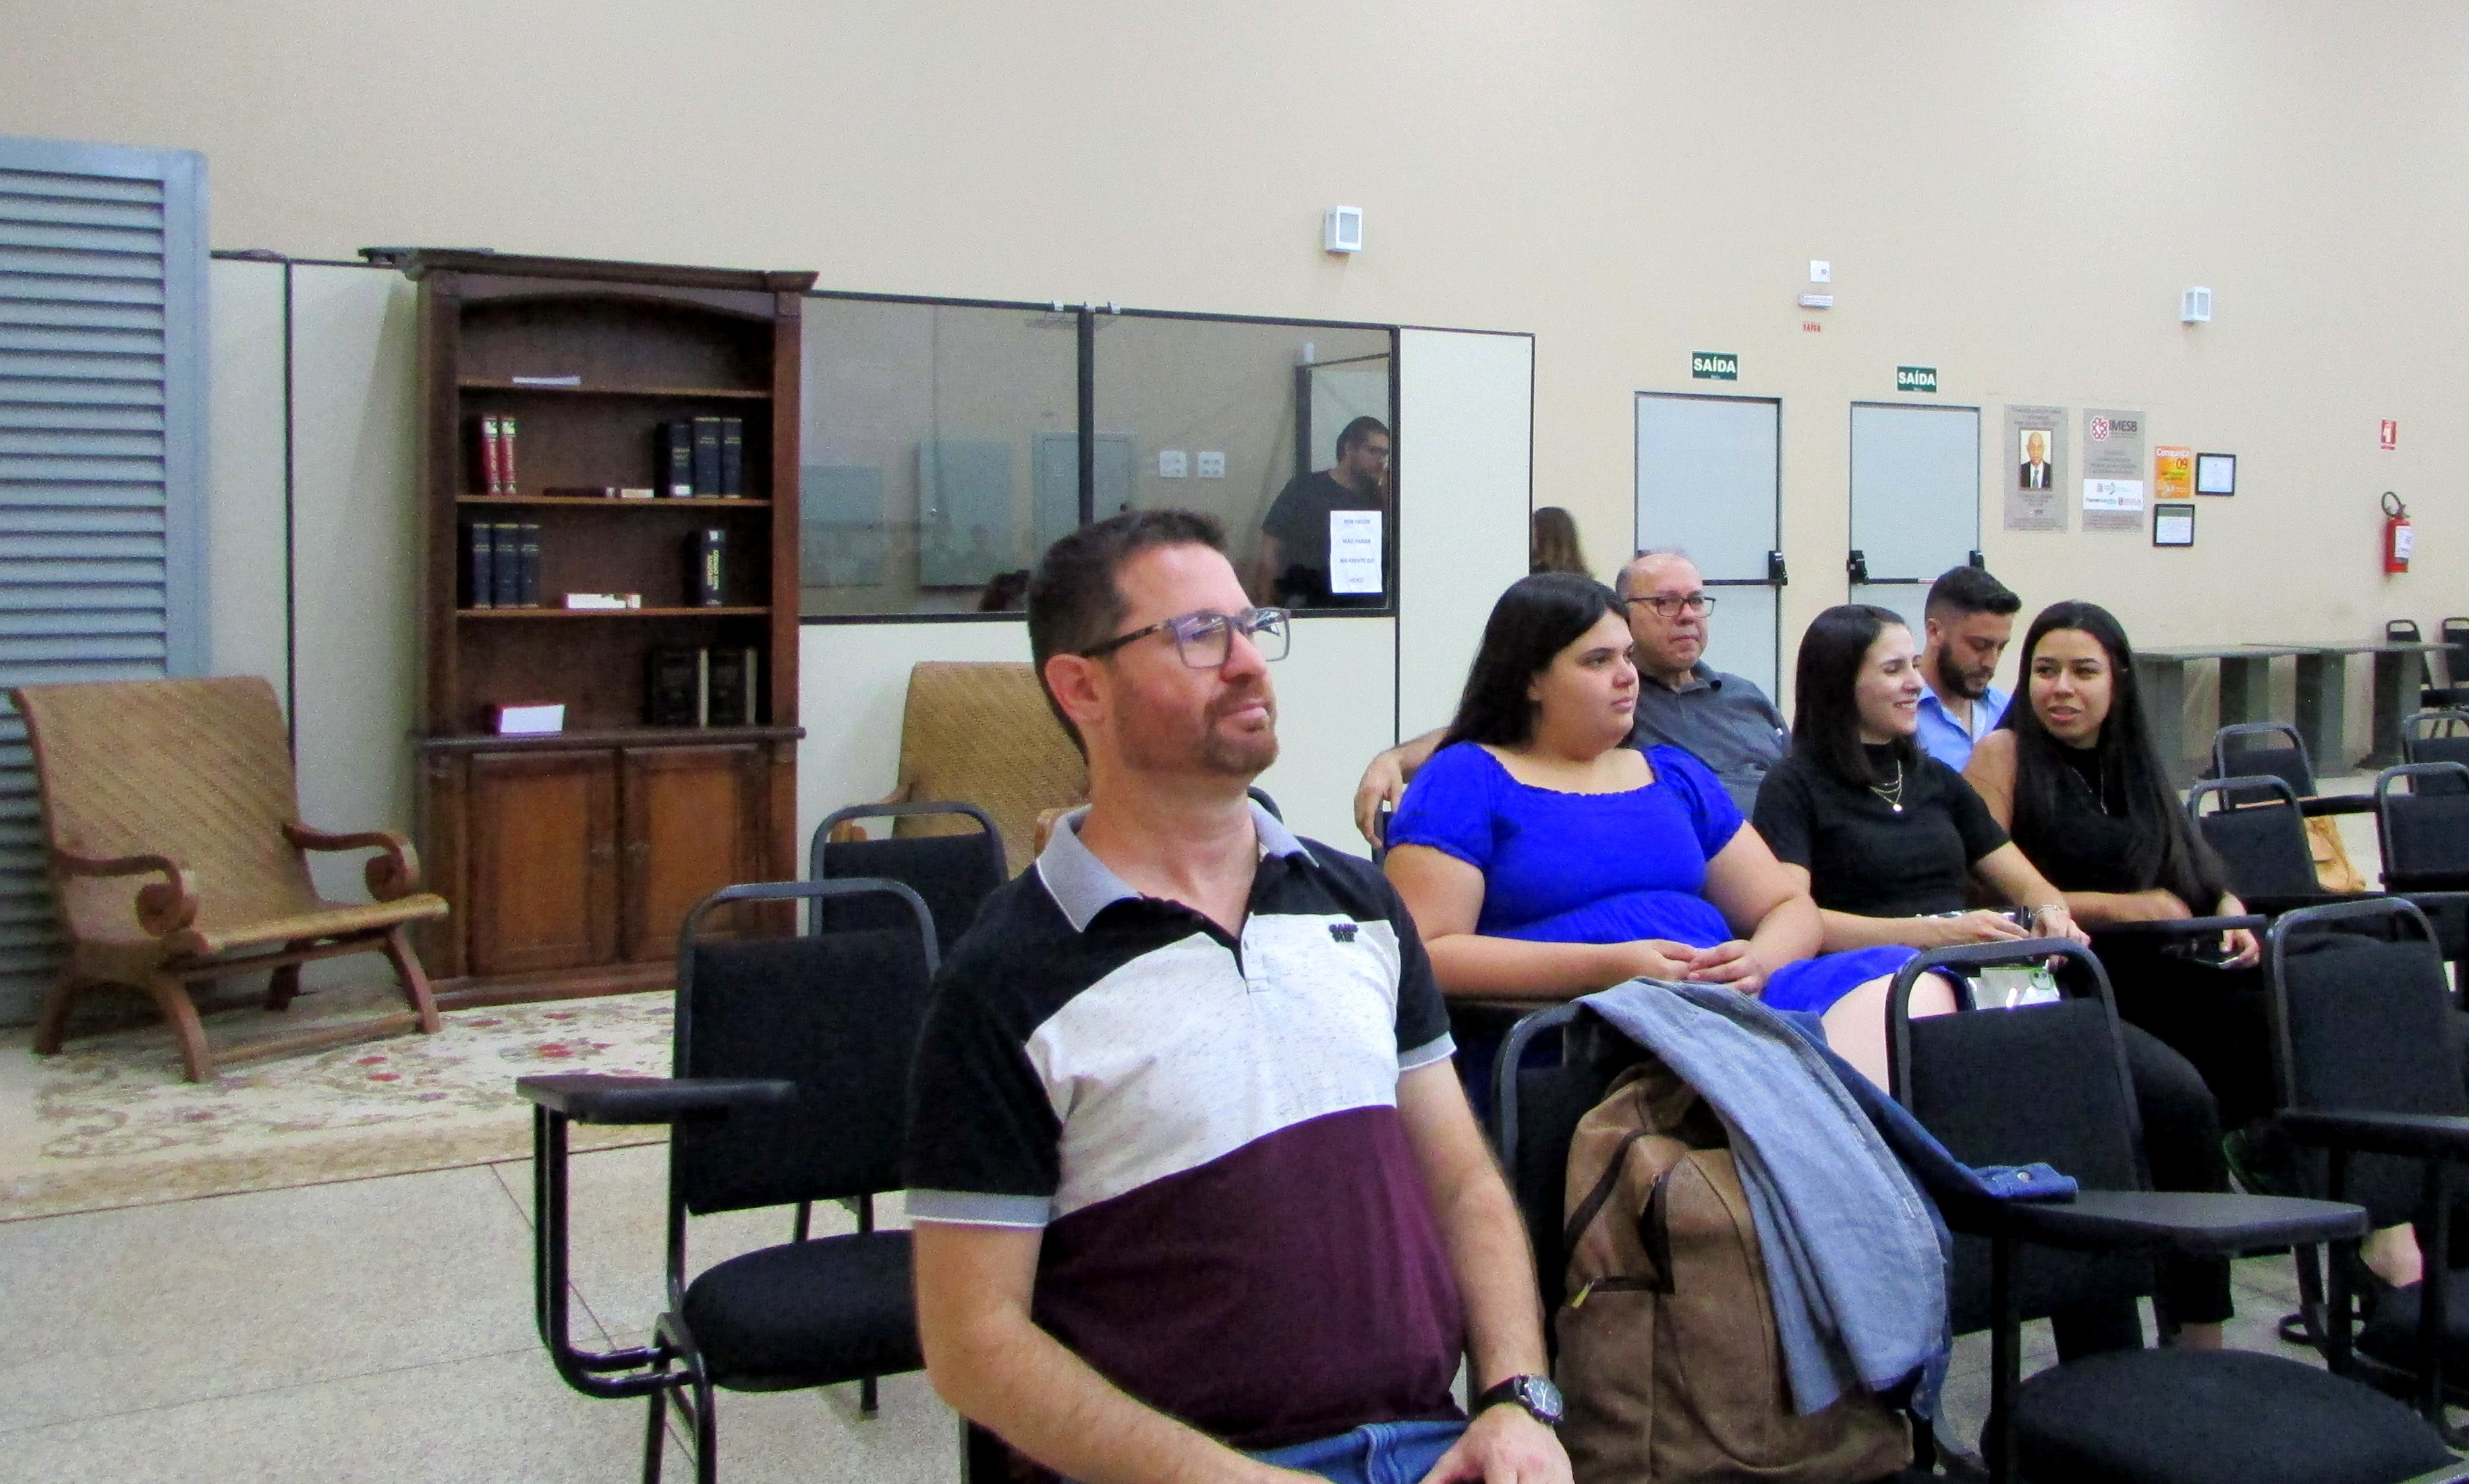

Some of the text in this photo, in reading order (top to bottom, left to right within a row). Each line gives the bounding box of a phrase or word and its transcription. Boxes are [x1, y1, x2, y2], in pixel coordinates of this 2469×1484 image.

[1693, 356, 1736, 373] SAÍDA
[1898, 370, 1935, 386] SAÍDA
[2109, 420, 2138, 432] IMESB
[2176, 458, 2188, 469] 09
